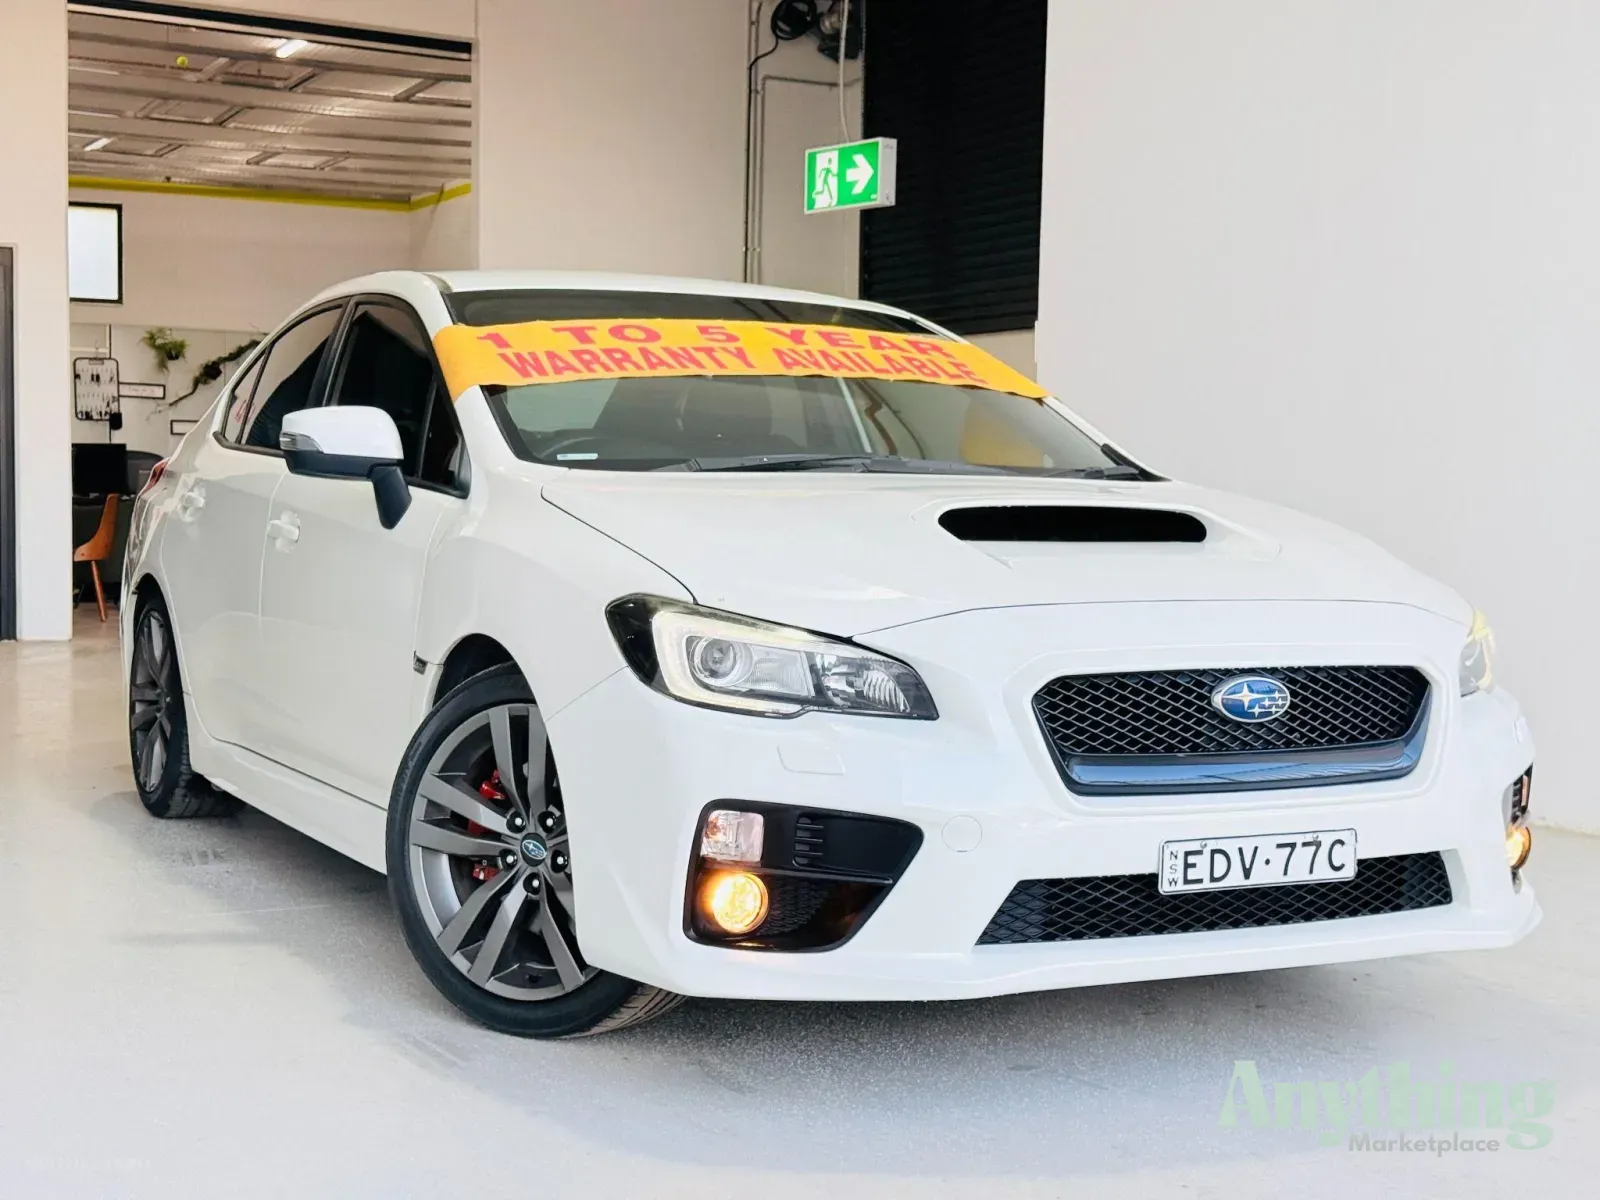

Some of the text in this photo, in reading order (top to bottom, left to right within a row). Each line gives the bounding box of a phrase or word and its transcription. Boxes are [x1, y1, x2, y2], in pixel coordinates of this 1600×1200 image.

[477, 324, 956, 359] 1 TO 5 YEAR
[498, 346, 988, 385] WARRANTY AVAILABLE
